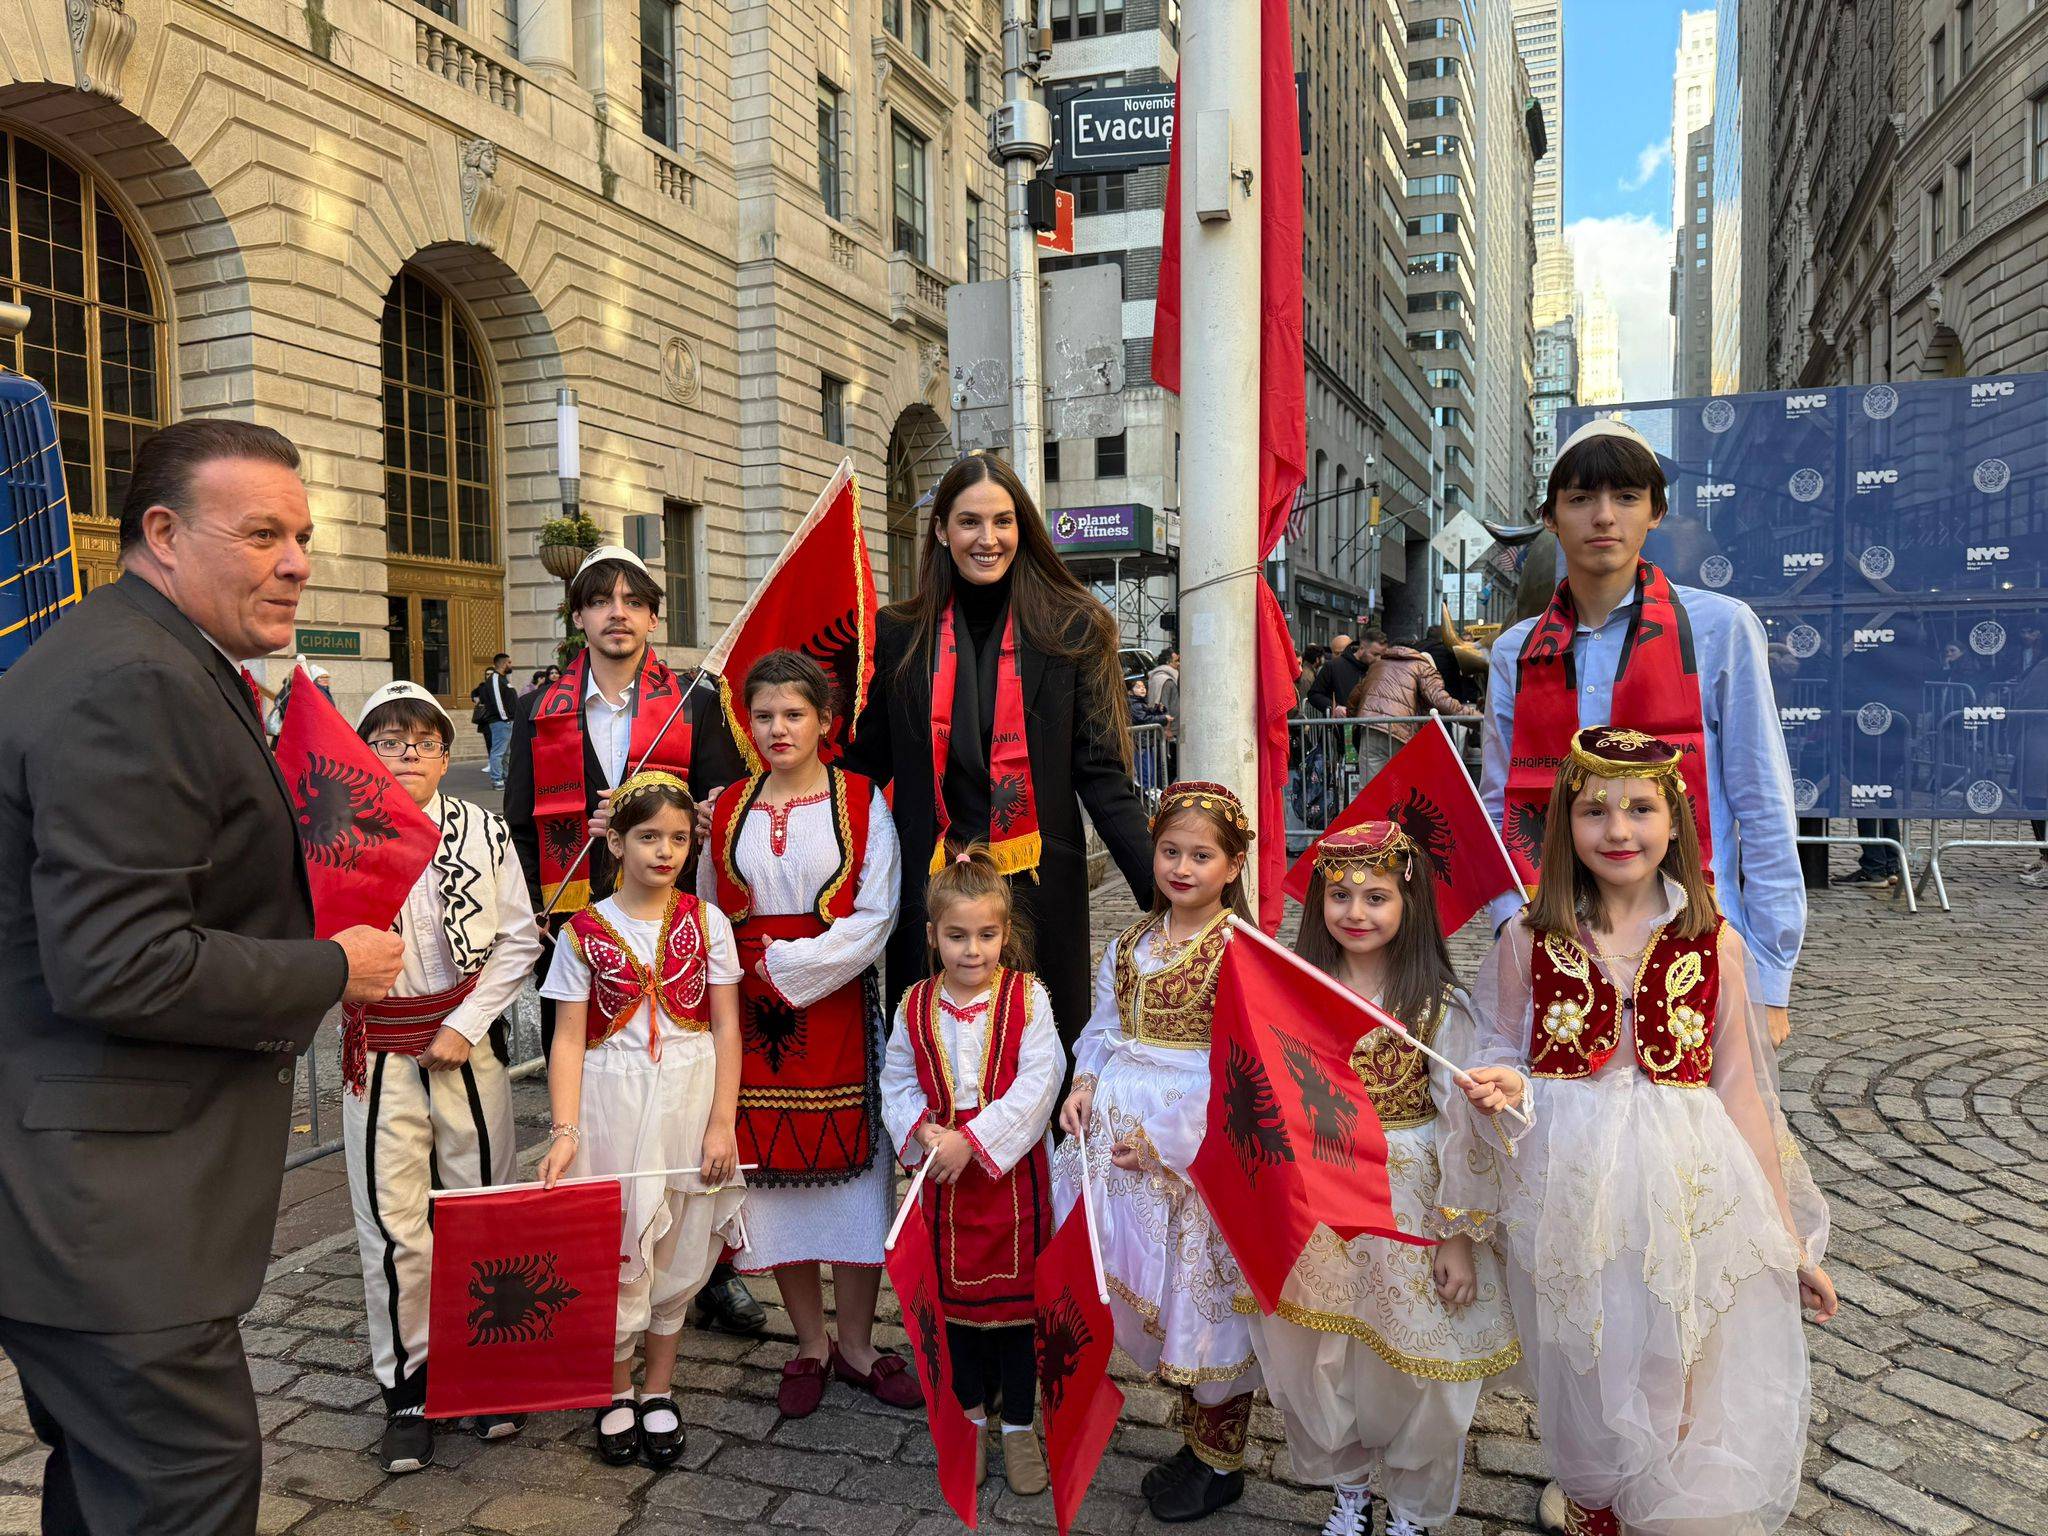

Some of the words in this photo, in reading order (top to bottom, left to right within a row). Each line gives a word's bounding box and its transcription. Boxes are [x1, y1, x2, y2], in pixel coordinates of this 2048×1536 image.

[1124, 97, 1176, 111] Novembe
[1078, 113, 1175, 143] Evacua
[1971, 381, 2015, 398] NYC
[1786, 394, 1827, 410] NYC
[1856, 469, 1898, 485] NYC
[1696, 483, 1736, 498] NYC
[1078, 513, 1120, 530] planet
[1083, 525, 1129, 538] fitness
[1783, 553, 1824, 567] NYC
[1967, 546, 2010, 561] NYC
[300, 635, 357, 649] CIPRIANI
[1854, 629, 1895, 643] NYC
[1781, 707, 1822, 721] NYC
[1964, 706, 2006, 720] NYC
[991, 731, 1021, 744] ANIA
[1511, 754, 1559, 768] SHQIPËR
[1852, 784, 1893, 798] NYC
